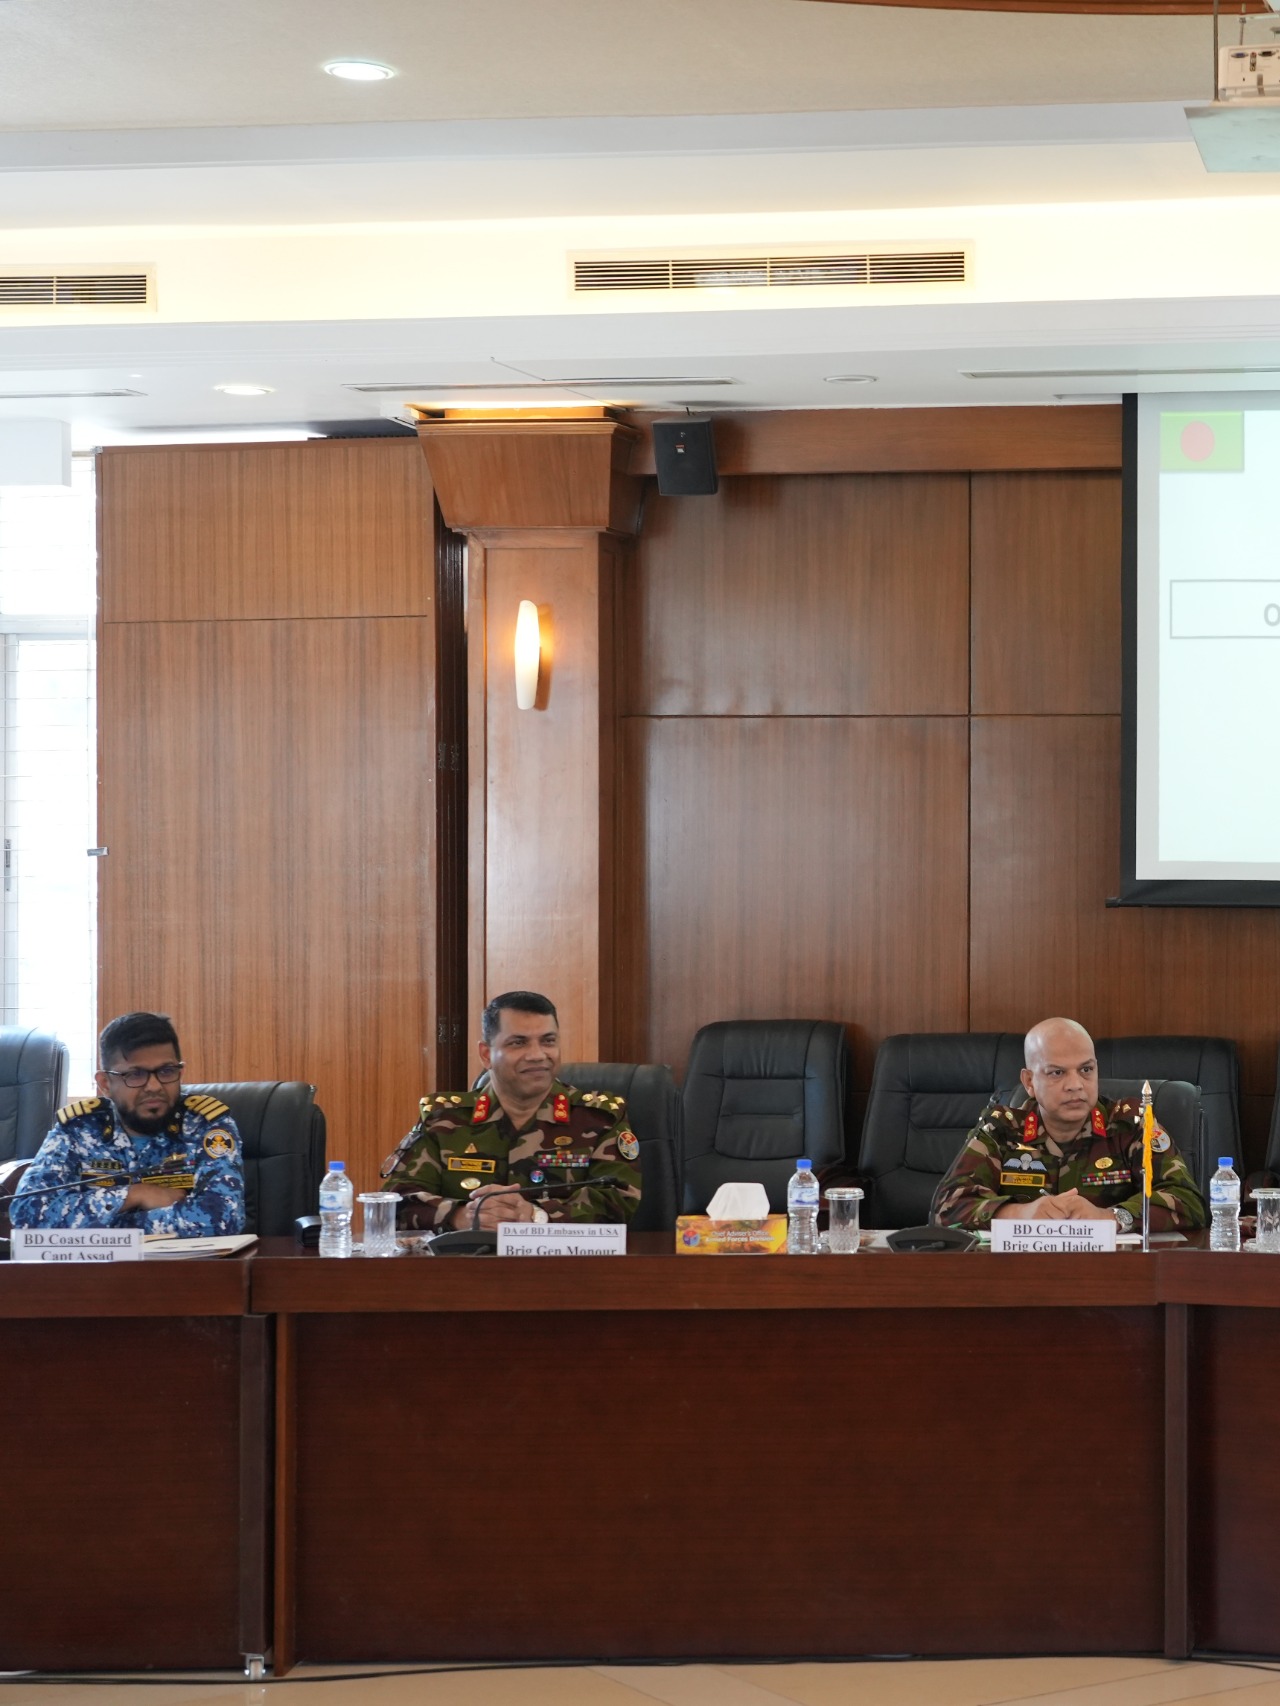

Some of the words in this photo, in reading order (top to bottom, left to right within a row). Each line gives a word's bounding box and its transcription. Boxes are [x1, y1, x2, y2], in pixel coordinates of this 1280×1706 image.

[503, 1227, 517, 1235] DA
[519, 1227, 529, 1235] of
[531, 1227, 545, 1235] BD
[587, 1227, 597, 1235] in
[599, 1228, 619, 1236] USA
[1013, 1224, 1032, 1235] BD
[1036, 1224, 1094, 1236] Co-Chair
[24, 1233, 44, 1245] BD
[48, 1233, 85, 1245] Coast
[89, 1233, 132, 1245] Guard
[536, 1245, 562, 1256] Gen
[1003, 1241, 1029, 1253] Brig
[1033, 1241, 1058, 1252] Gen
[1062, 1241, 1104, 1252] Haider
[78, 1250, 114, 1261] Assad
